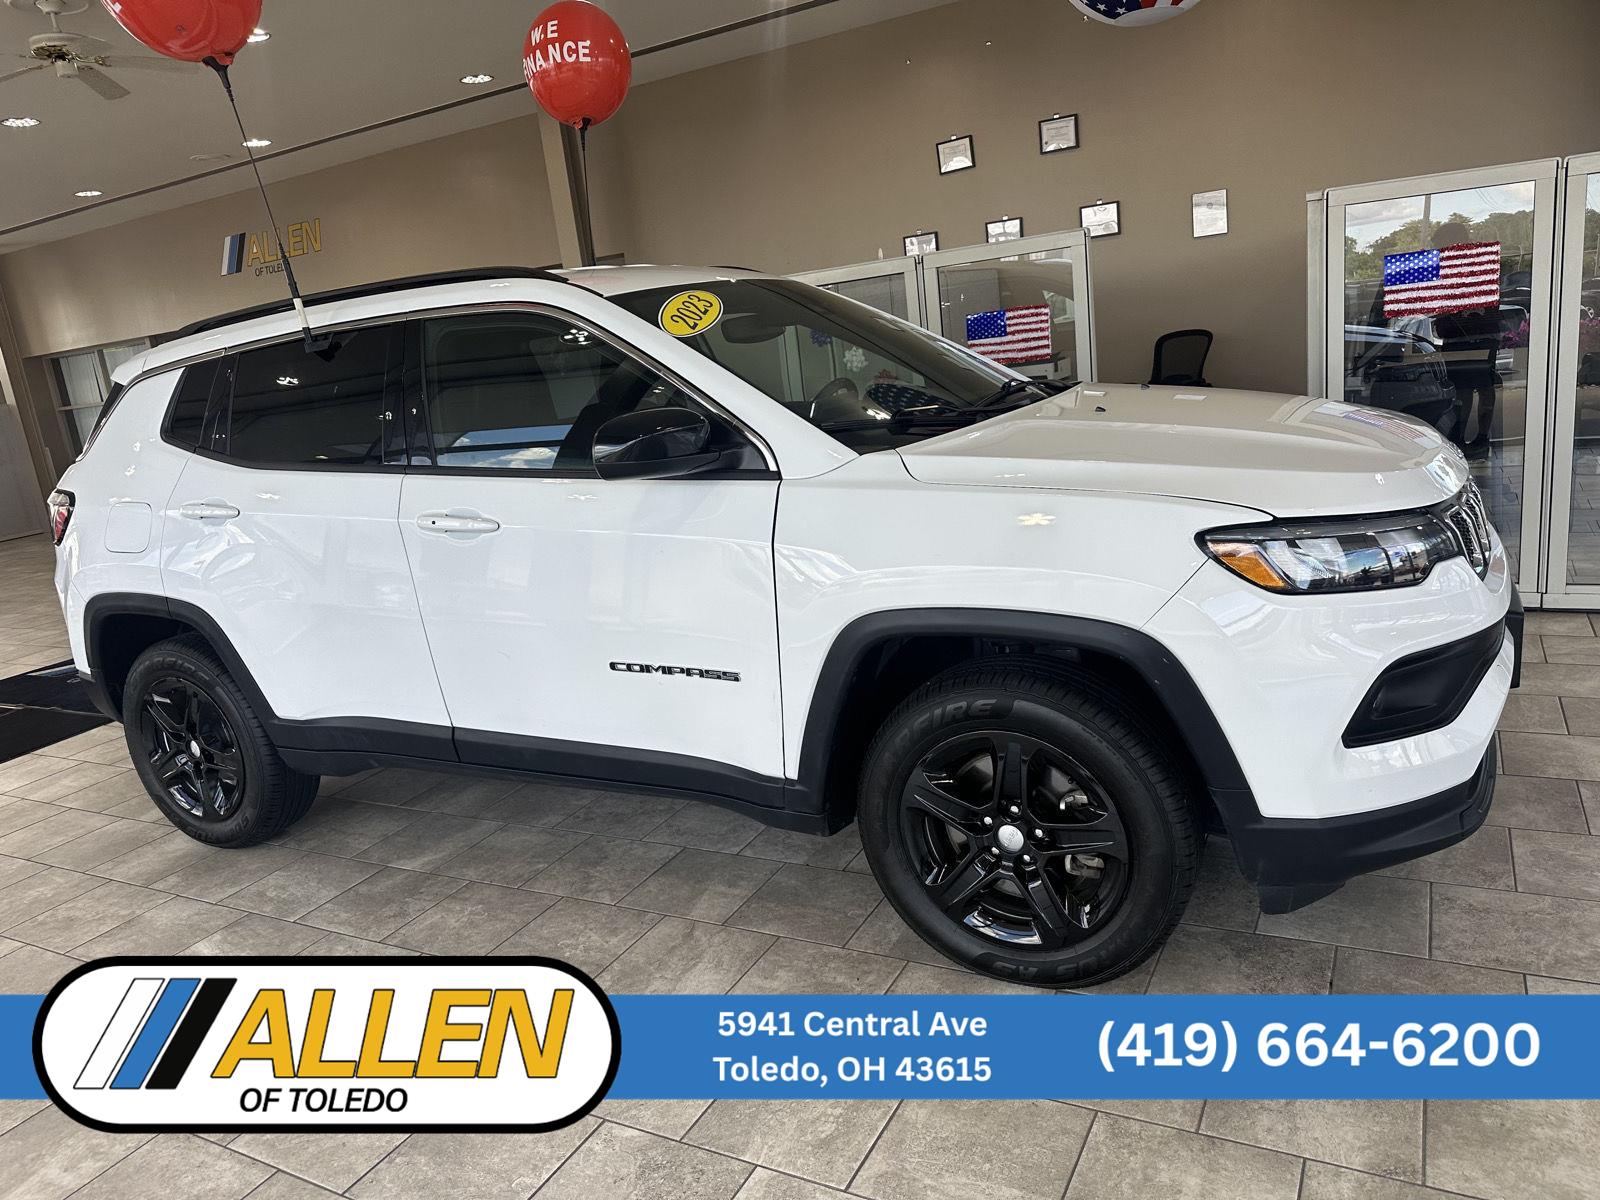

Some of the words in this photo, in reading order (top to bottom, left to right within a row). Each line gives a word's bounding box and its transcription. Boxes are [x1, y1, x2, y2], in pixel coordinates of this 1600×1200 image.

[531, 20, 558, 46] WE
[522, 40, 591, 83] INANCE
[254, 266, 264, 277] OF
[670, 294, 713, 330] 2023
[610, 662, 740, 682] COMPASS
